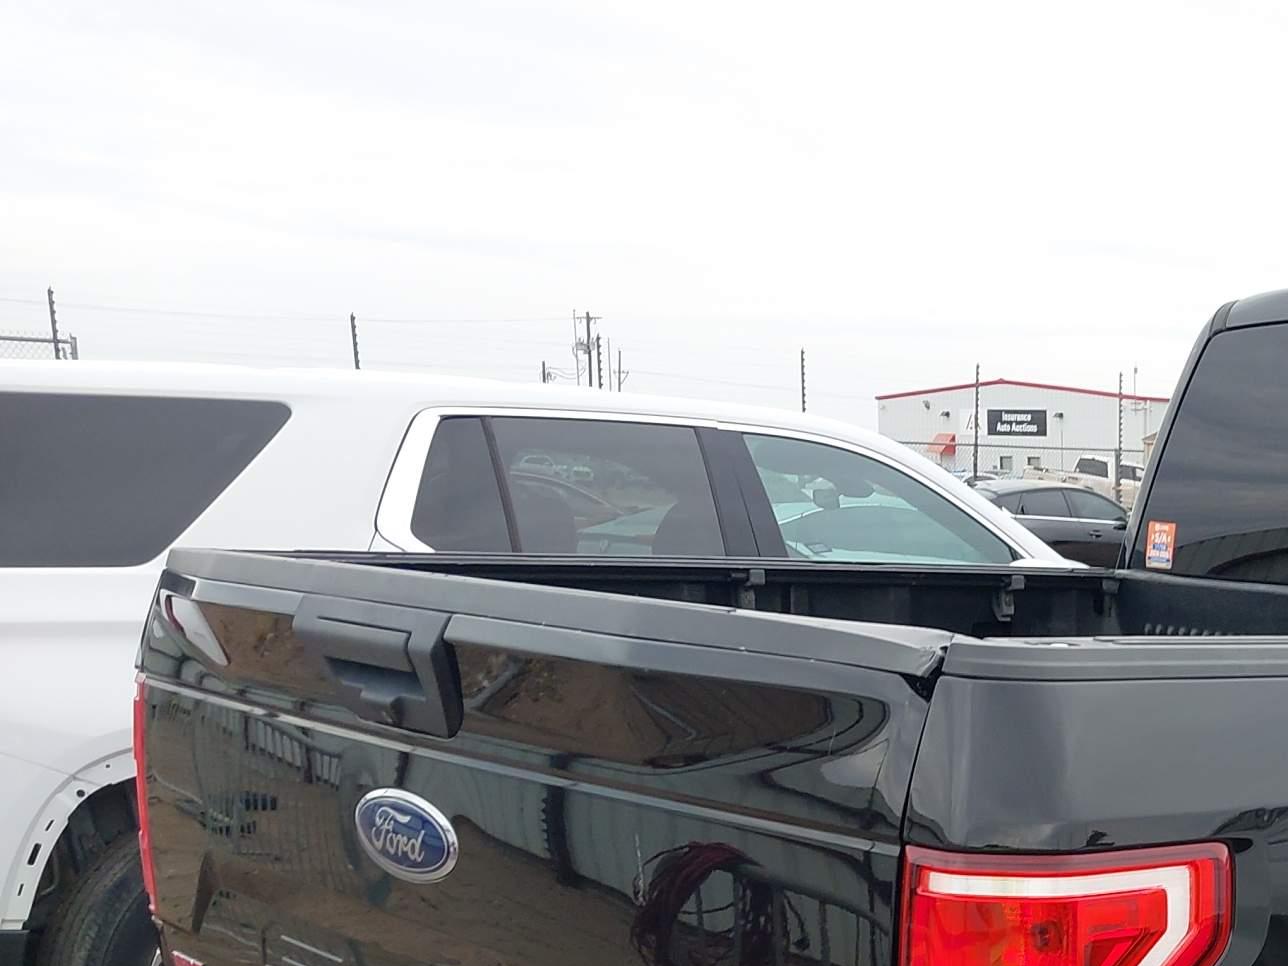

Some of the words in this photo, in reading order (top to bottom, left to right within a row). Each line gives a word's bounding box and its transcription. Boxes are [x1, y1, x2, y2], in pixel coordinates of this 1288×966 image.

[1001, 411, 1032, 422] Insurance
[996, 422, 1010, 432] Auto
[1011, 422, 1038, 433] Auctions
[370, 805, 426, 863] Ford
